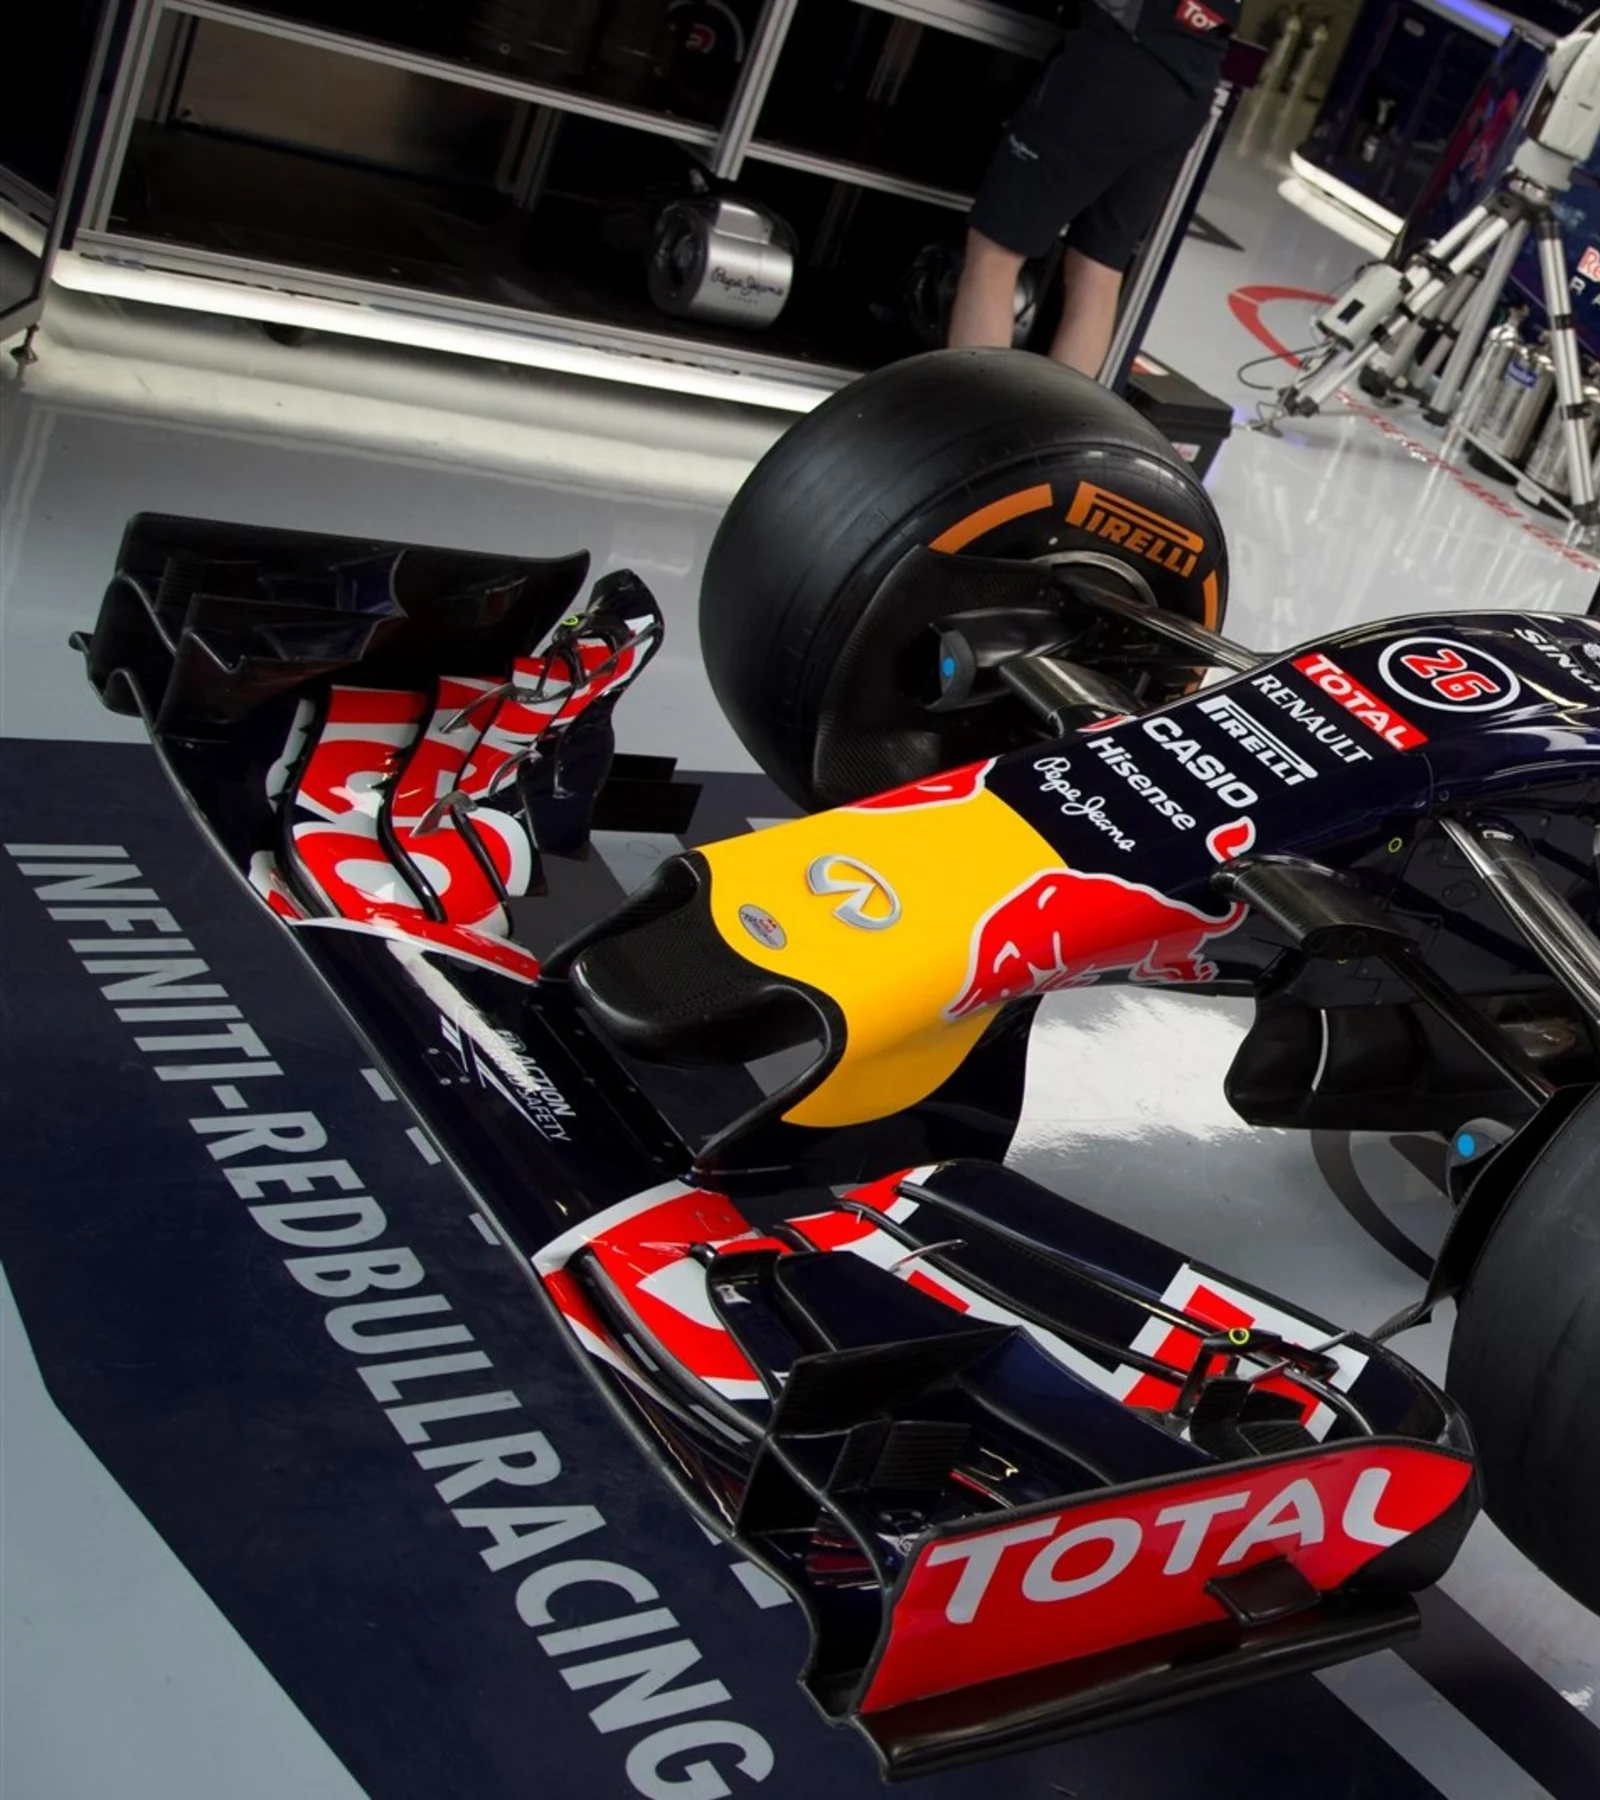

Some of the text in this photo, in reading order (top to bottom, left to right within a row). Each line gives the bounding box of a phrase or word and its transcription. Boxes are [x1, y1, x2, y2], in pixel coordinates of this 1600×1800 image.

[1065, 479, 1204, 577] PIRELLI
[1251, 674, 1374, 764] RENAULT
[1304, 653, 1410, 750] TOTAL
[1400, 648, 1502, 701] 26
[1087, 736, 1197, 831] Hisense
[1141, 716, 1259, 809] CASIO
[1197, 695, 1319, 787] PIRELLI
[1033, 757, 1137, 854] Pepe Jeans
[514, 1053, 577, 1118] ACTION
[516, 1085, 573, 1142] SAFETY
[926, 1467, 1411, 1626] TOTAL
